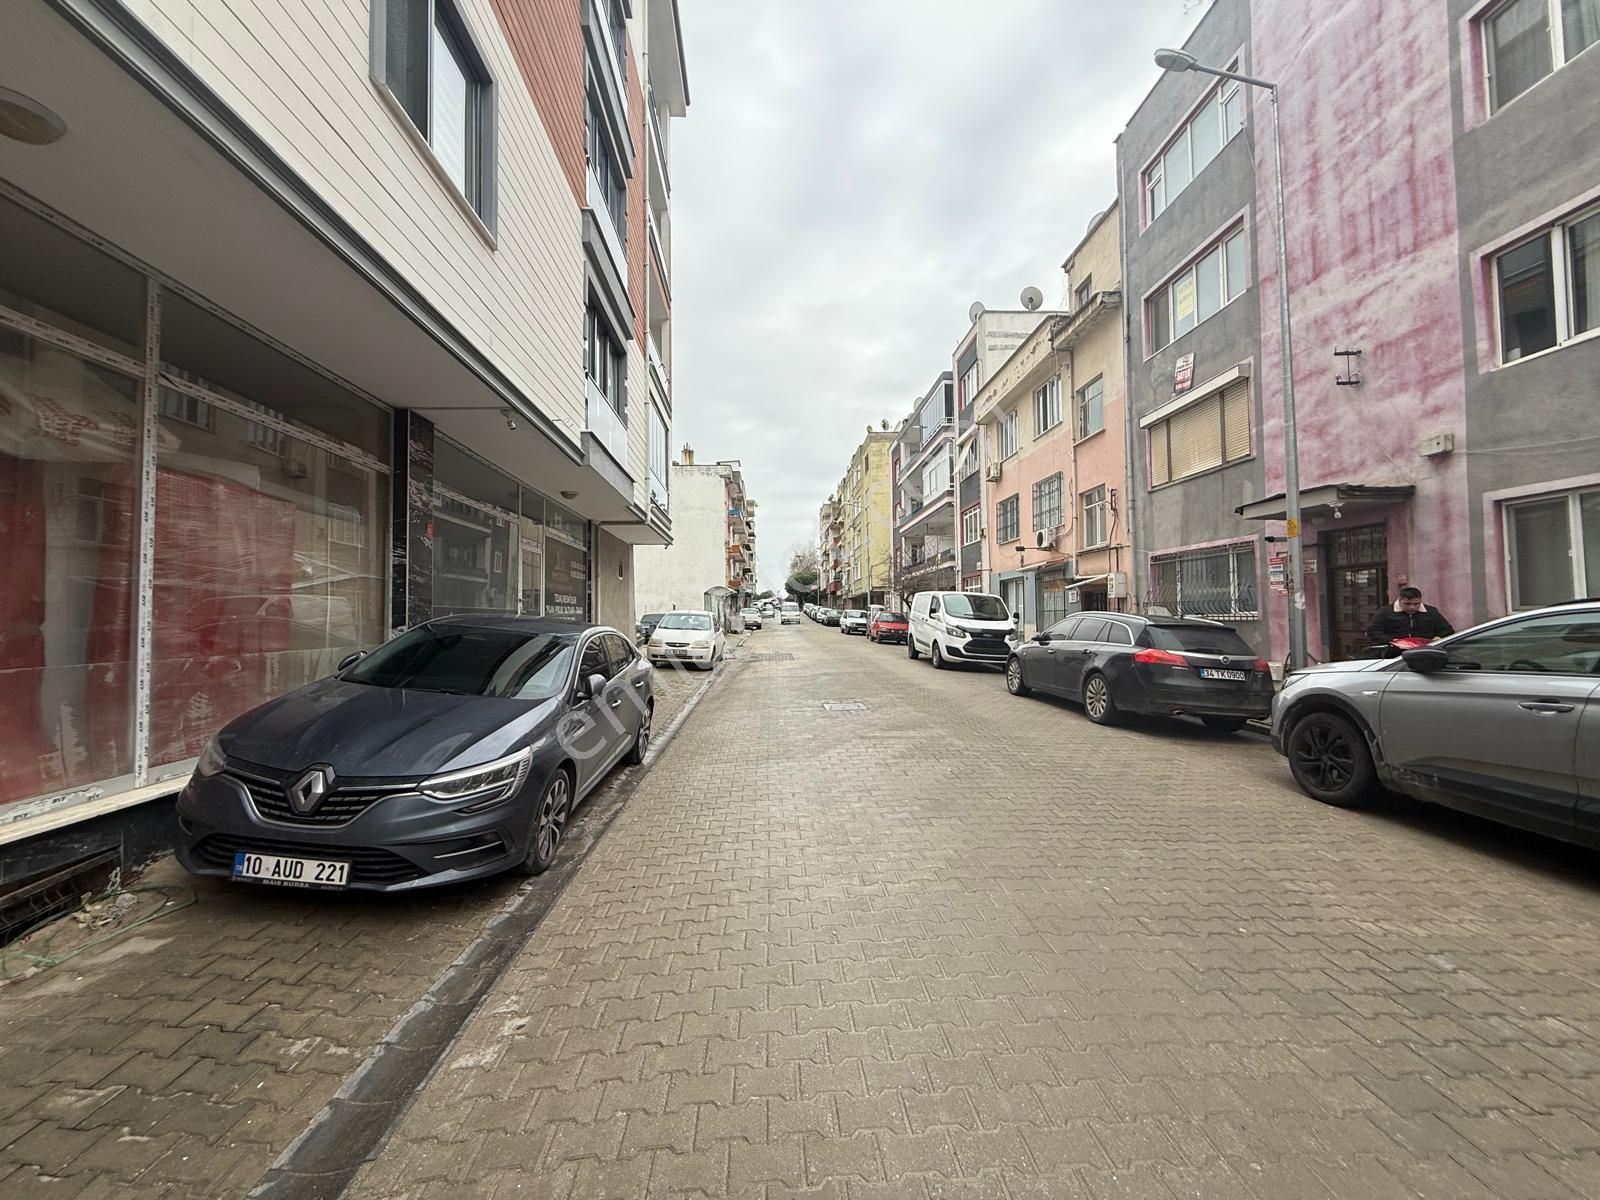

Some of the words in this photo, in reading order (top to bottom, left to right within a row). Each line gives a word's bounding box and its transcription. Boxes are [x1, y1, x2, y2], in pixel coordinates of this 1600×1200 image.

[1204, 669, 1215, 677] 34
[1215, 670, 1226, 678] TK
[245, 855, 263, 876] 10
[271, 858, 305, 879] AUD
[314, 862, 346, 883] 221
